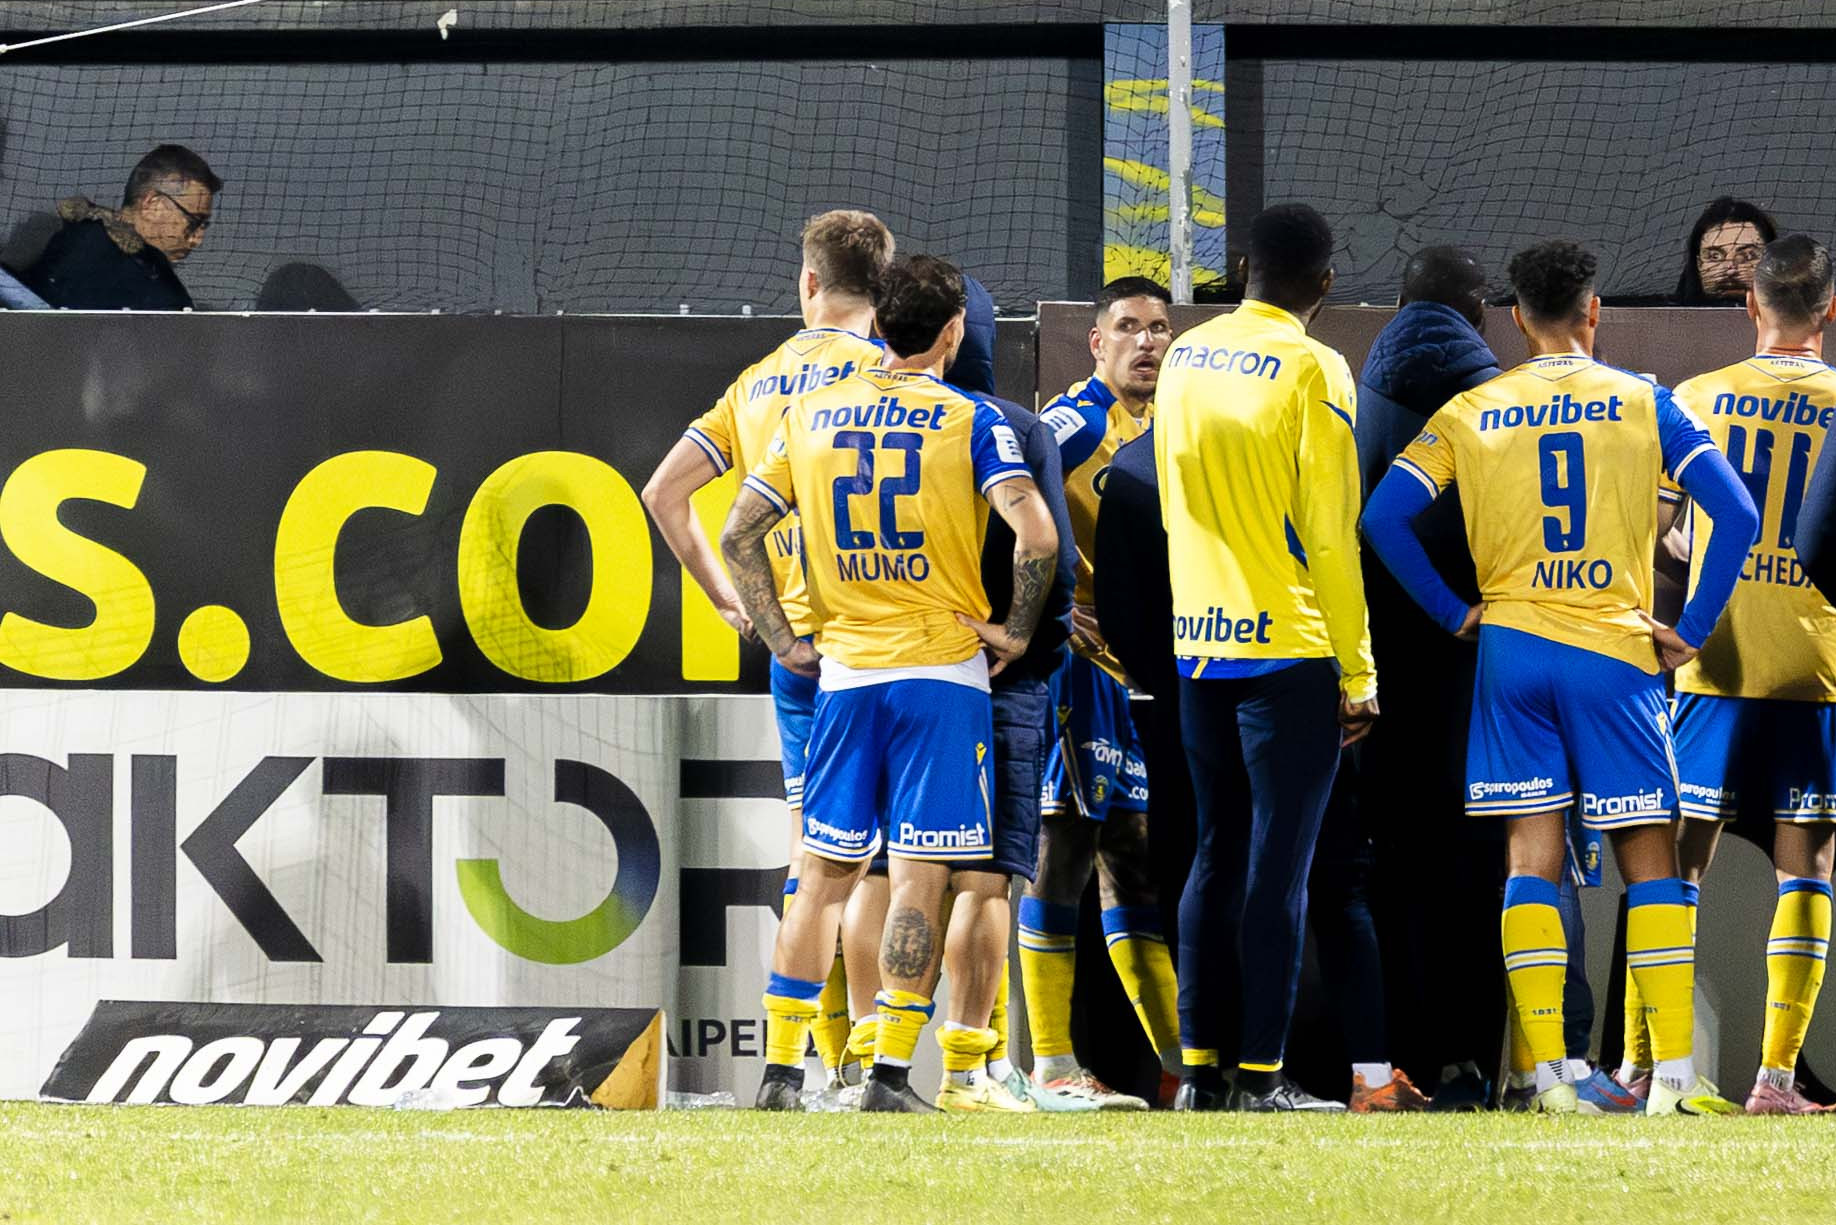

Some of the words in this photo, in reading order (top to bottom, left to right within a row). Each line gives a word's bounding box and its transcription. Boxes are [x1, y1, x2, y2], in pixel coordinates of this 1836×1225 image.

[749, 360, 856, 403] novibet
[1168, 344, 1283, 381] macron
[810, 396, 948, 431] novibet
[1480, 393, 1624, 432] novibet
[832, 430, 925, 550] 22
[1538, 431, 1587, 553] 9
[0, 449, 740, 683] s.co
[836, 553, 930, 583] MUMO
[1531, 559, 1614, 590] NIKO
[1583, 788, 1664, 816] Promist
[899, 822, 985, 847] Promist
[87, 1011, 581, 1108] novibet
